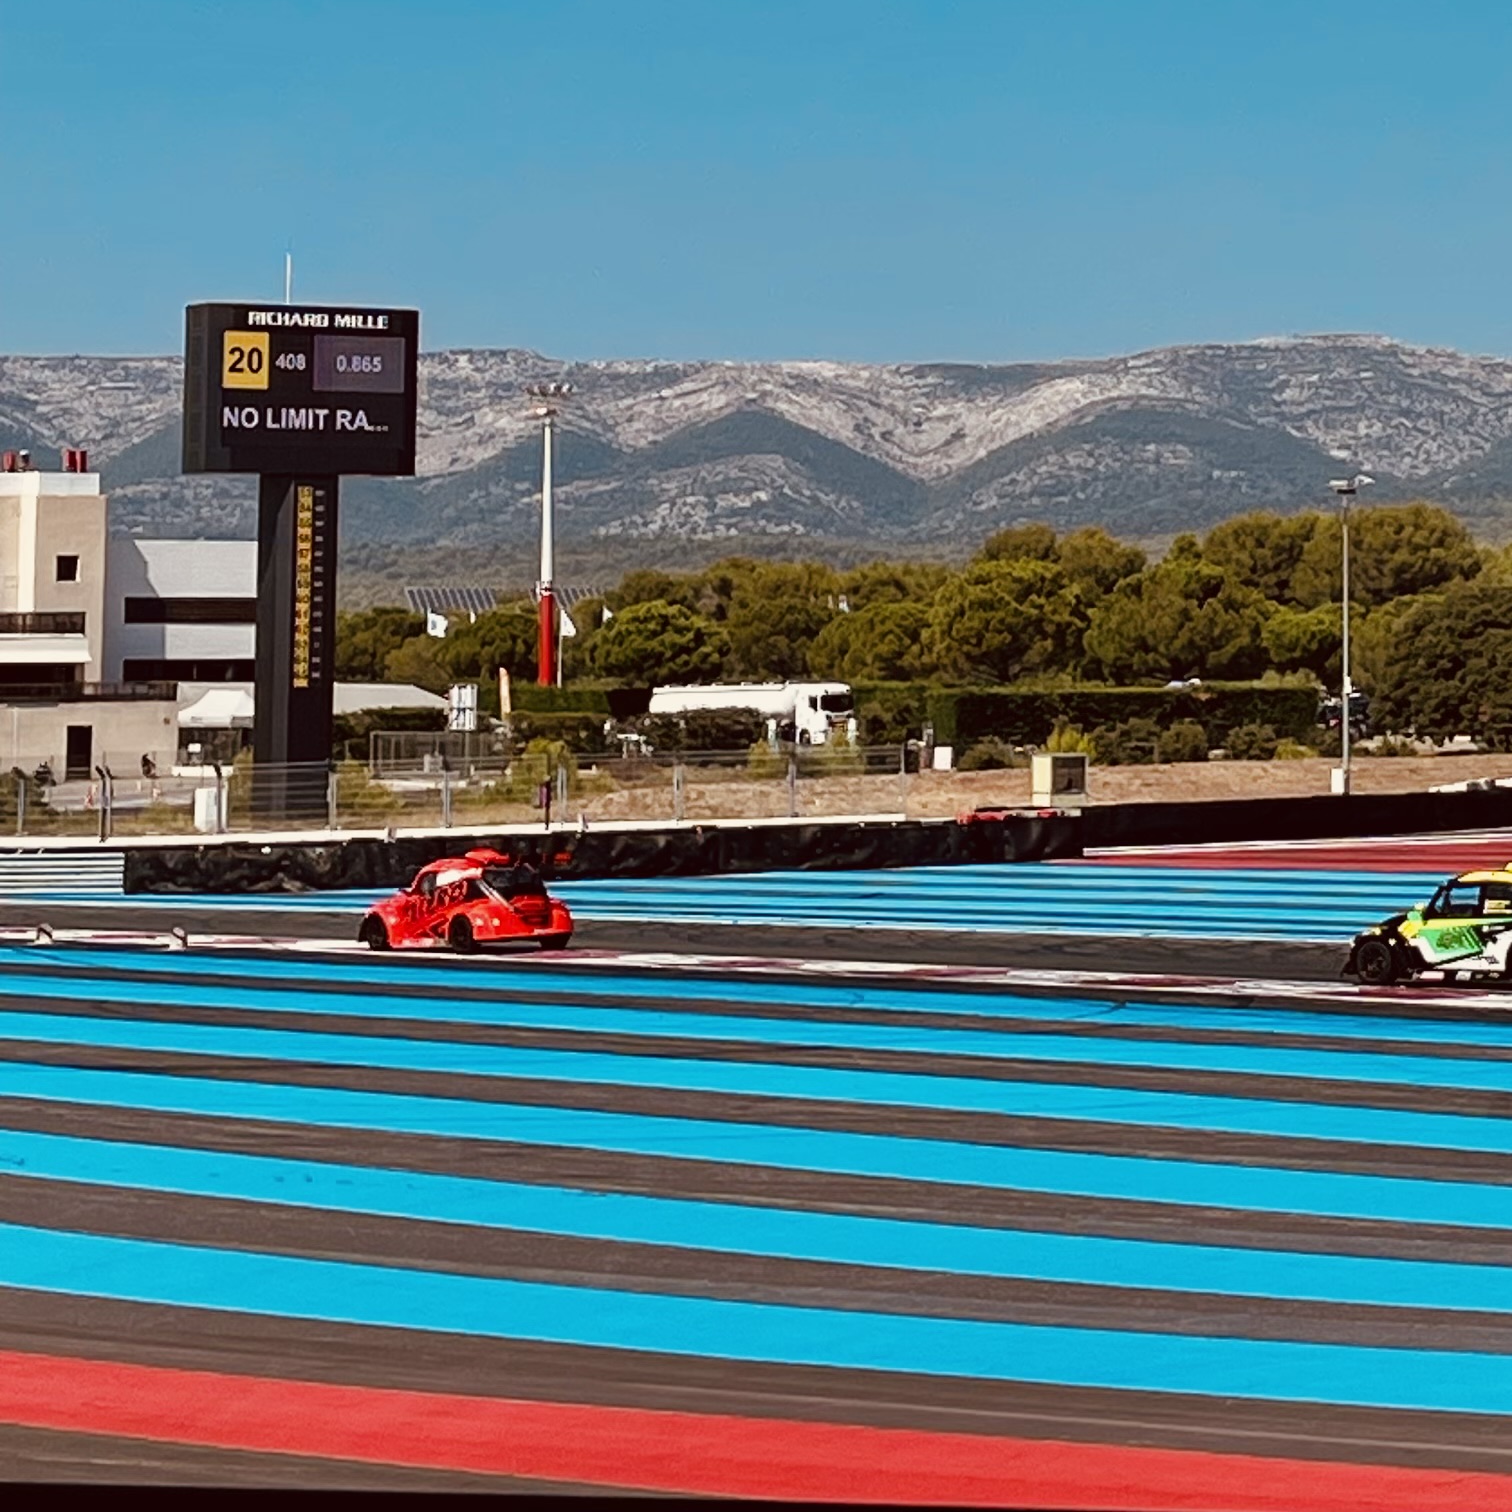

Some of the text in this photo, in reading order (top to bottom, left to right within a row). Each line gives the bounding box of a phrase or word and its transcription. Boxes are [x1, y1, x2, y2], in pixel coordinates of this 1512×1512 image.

[248, 311, 389, 329] RICHARD MILLE
[229, 346, 263, 374] 20
[275, 353, 306, 371] 408
[223, 406, 259, 429] NO
[266, 407, 329, 430] LIMIT
